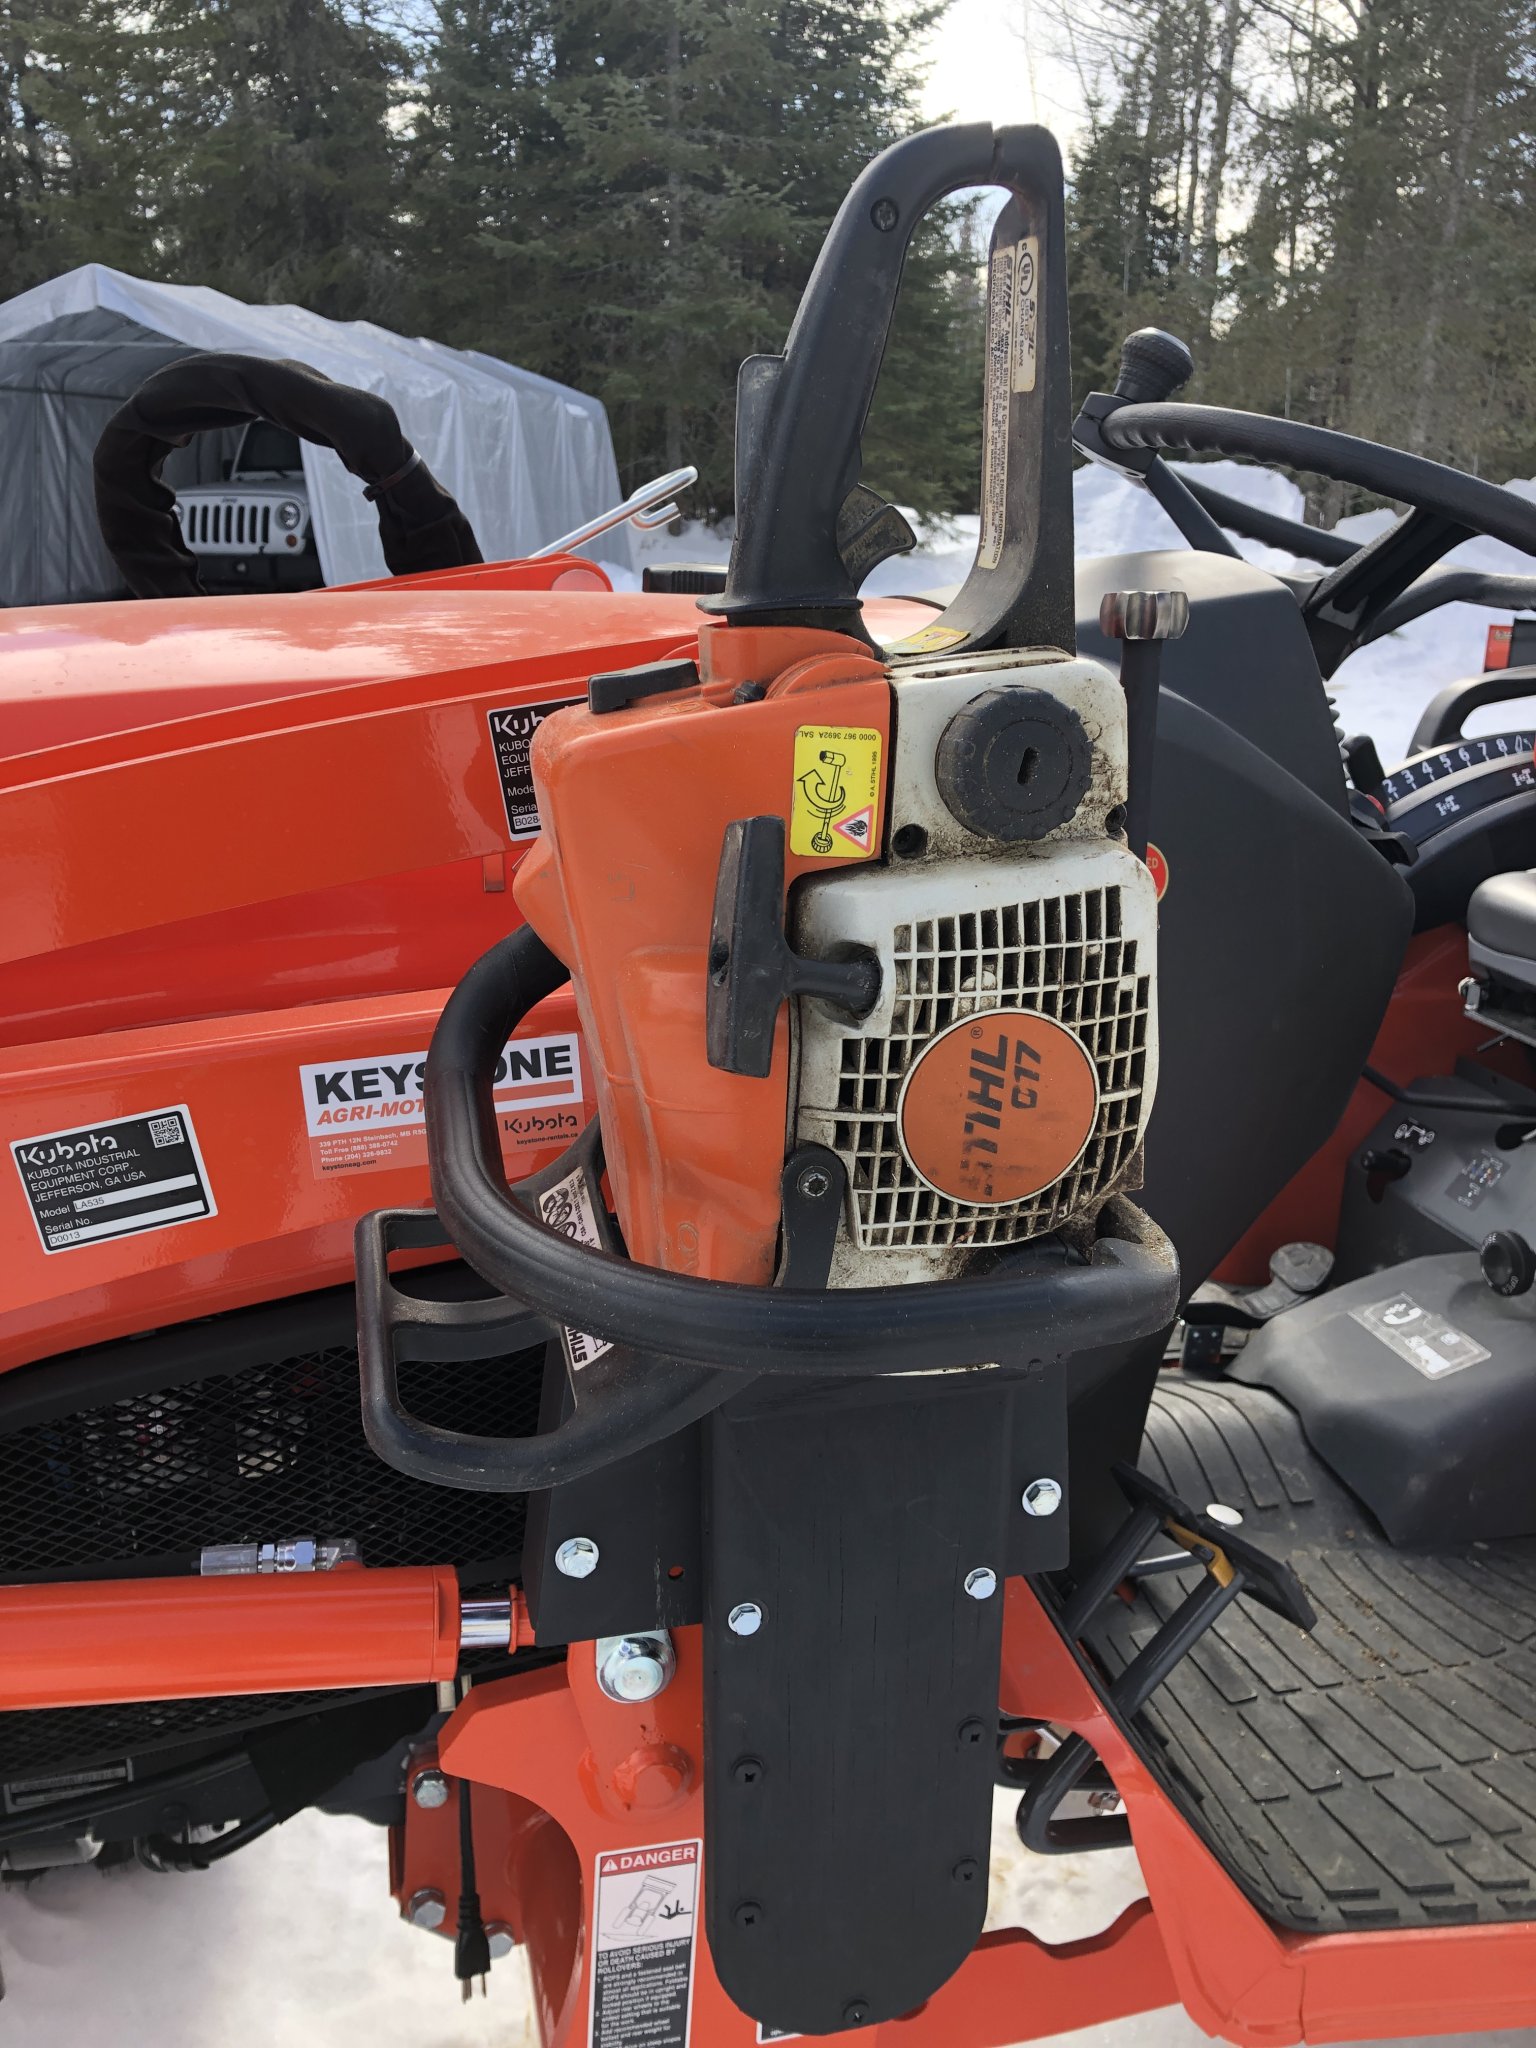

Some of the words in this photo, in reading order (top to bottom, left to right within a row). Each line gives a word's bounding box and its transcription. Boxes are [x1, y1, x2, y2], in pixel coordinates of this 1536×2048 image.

[1021, 263, 1030, 286] UL
[1002, 390, 1008, 402] AG
[992, 511, 1003, 564] INFORMATION
[499, 738, 532, 752] KUBO
[1382, 778, 1397, 794] 2
[1402, 770, 1414, 784] 3
[1422, 761, 1432, 775] 4
[1439, 754, 1450, 768] 5
[1458, 748, 1470, 762] 6
[1478, 742, 1488, 756] 7
[1496, 738, 1507, 752] 8
[507, 785, 535, 797] Mode
[511, 803, 538, 815] Seria
[515, 816, 540, 826] B028
[504, 1113, 578, 1134] Kubota
[363, 1132, 398, 1142] Steinbach,
[516, 1132, 578, 1145] keystone-rentals.ca
[20, 1134, 118, 1166] Kubota
[27, 1163, 73, 1181] KUBOTA
[75, 1148, 141, 1170] INDUSTRIAL
[322, 1159, 377, 1171] keystoneag.com
[31, 1170, 95, 1192] EQUIPMENT
[98, 1162, 134, 1177] CORP.
[35, 1181, 103, 1203] JEFFERSON,
[104, 1176, 121, 1187] GA
[123, 1170, 146, 1183] USA
[39, 1205, 71, 1219] Model
[75, 1197, 105, 1210] LA535
[45, 1221, 73, 1234] Serial
[75, 1217, 93, 1228] No.
[50, 1231, 81, 1245] D0013
[620, 1847, 695, 1870] DANGER
[610, 1948, 631, 1958] AVOID
[632, 1943, 664, 1954] SERIOUS
[665, 1938, 690, 1949] INJURY
[610, 1956, 634, 1965] DEATH
[635, 1950, 664, 1961] CAUSED
[665, 1948, 676, 1956] BY
[598, 1962, 643, 1974] ROLLOVERS:
